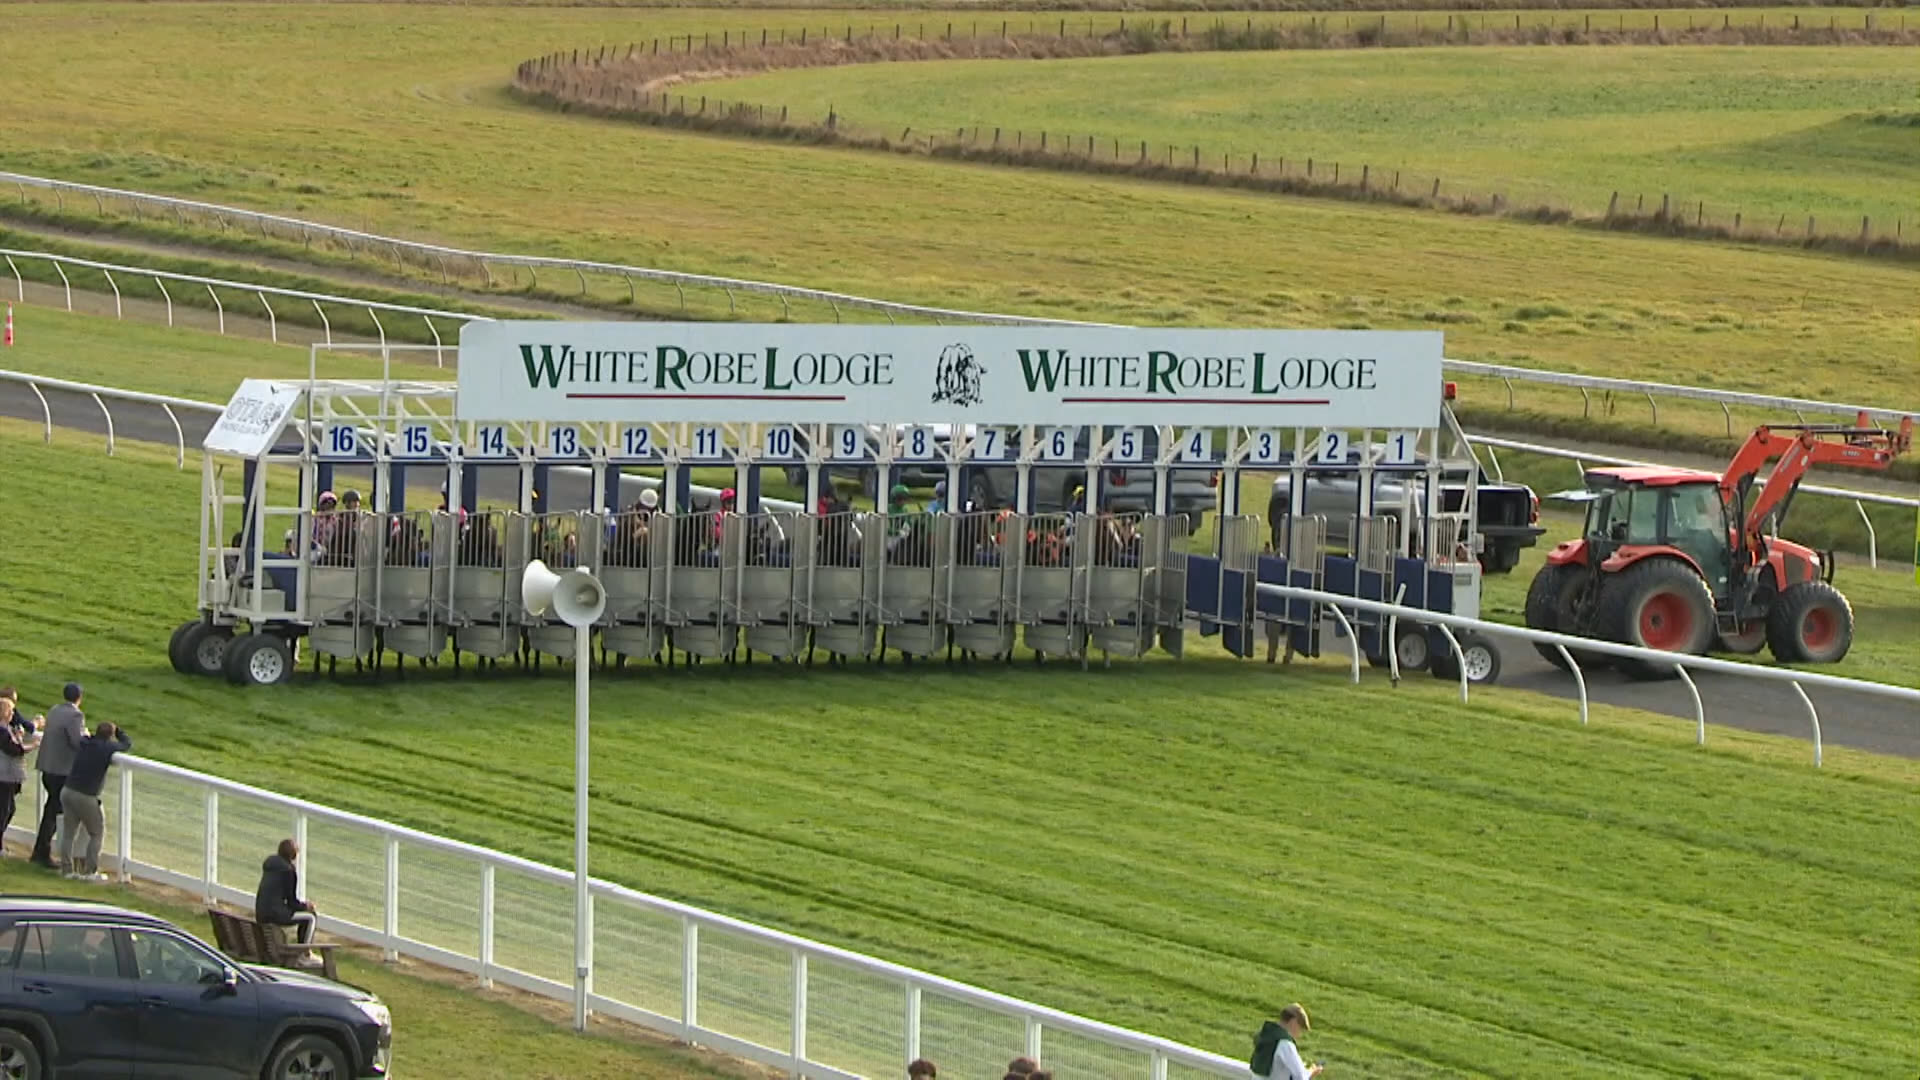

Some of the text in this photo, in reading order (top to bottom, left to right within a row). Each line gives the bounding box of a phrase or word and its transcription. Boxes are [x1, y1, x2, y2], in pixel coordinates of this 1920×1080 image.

[519, 345, 894, 391] WHITE ROBE LODGE
[1016, 349, 1377, 394] WHITE ROBE LODGE
[329, 426, 353, 452] 16
[403, 426, 427, 453] 15
[480, 427, 503, 454] 14
[552, 427, 575, 454] 13
[624, 428, 647, 454] 12
[696, 428, 715, 454] 11
[768, 429, 790, 455] 10
[843, 429, 856, 455] 9
[911, 429, 925, 455] 8
[983, 430, 997, 455] 7
[1051, 430, 1066, 456] 6
[1121, 431, 1135, 457] 5
[1189, 431, 1204, 457] 4
[1258, 432, 1272, 458] 3
[1326, 433, 1339, 459] 2
[1394, 433, 1405, 460] 1
